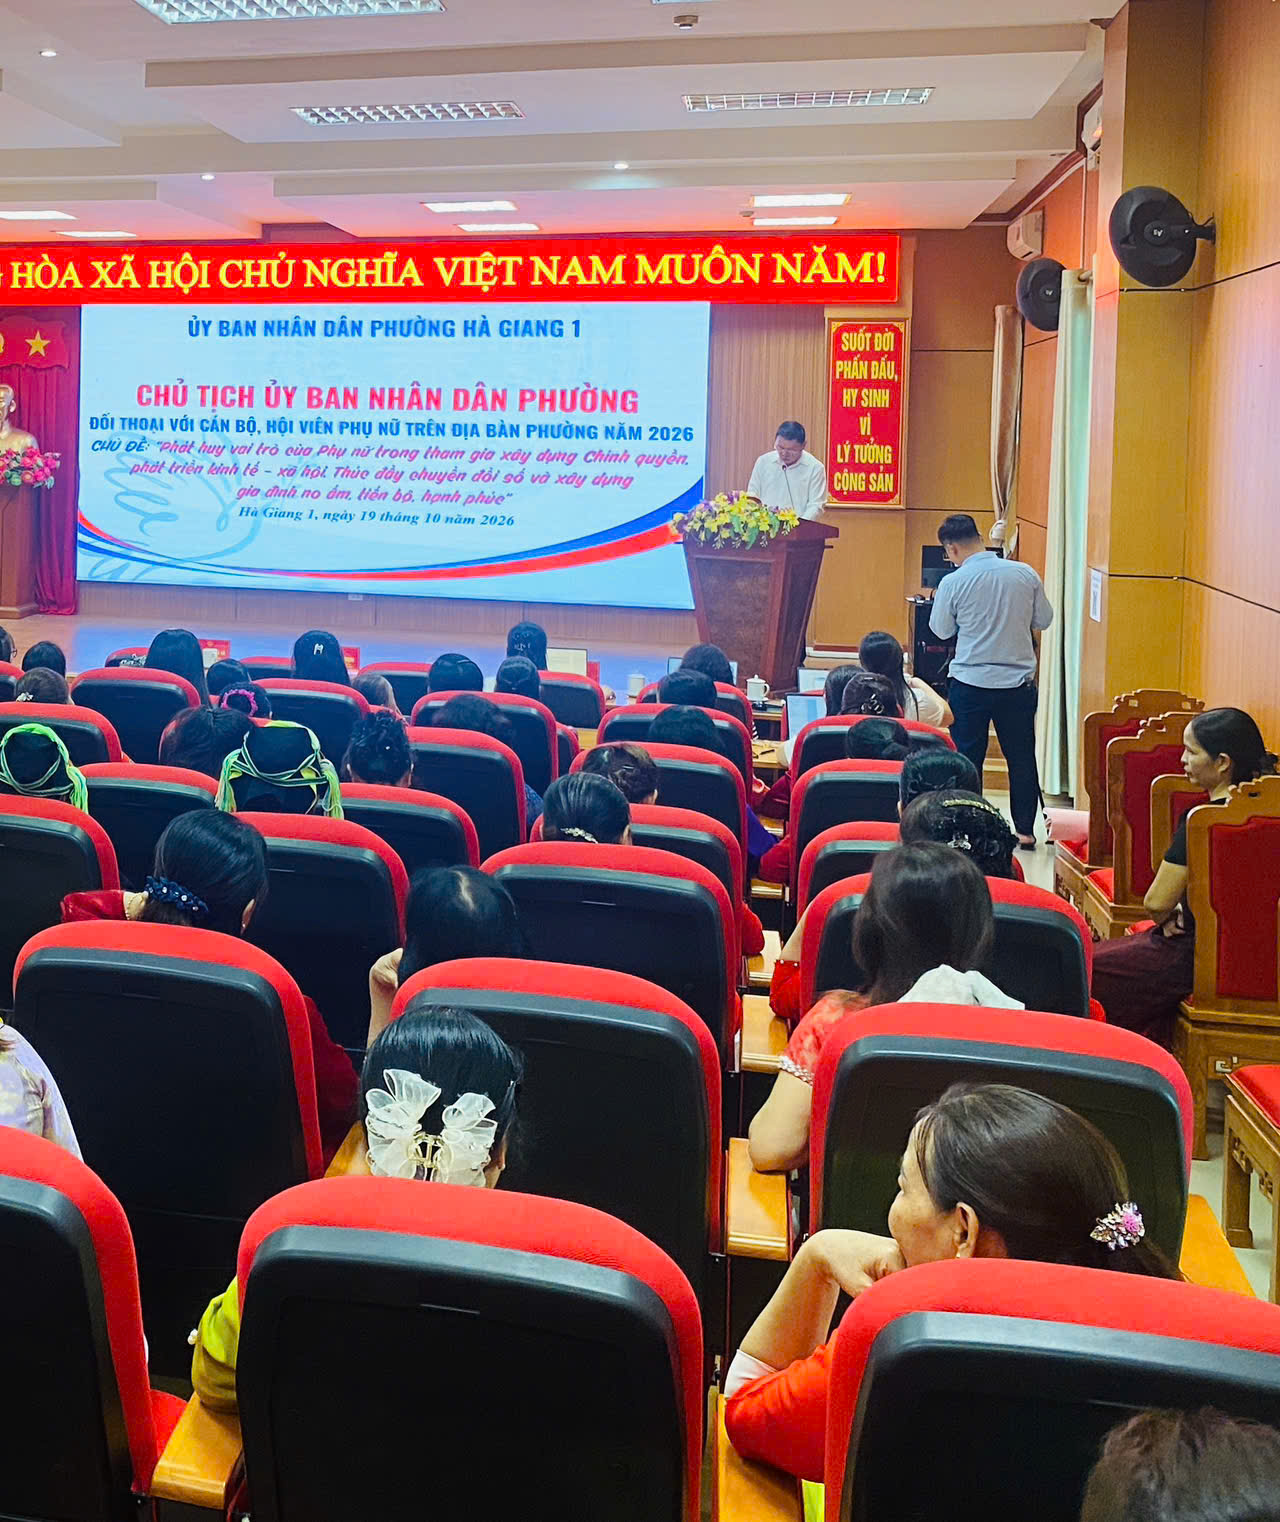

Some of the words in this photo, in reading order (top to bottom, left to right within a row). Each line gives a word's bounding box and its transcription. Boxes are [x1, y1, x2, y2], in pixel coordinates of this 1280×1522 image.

[11, 254, 83, 289] HÒA
[91, 255, 141, 289] XÃ
[148, 253, 210, 295] HỘI
[220, 253, 293, 288] CHỦ
[303, 252, 424, 288] NGHĨA
[434, 252, 522, 292] VIỆT
[531, 256, 626, 285] NAM
[635, 245, 760, 285] MUÔN
[772, 245, 886, 284] NĂM!
[188, 317, 213, 338] ỦY
[219, 320, 257, 338] BAN
[263, 316, 317, 338] NHÂN
[323, 316, 364, 339] DÂN
[370, 316, 456, 339] PHƯỜNG
[462, 315, 492, 339] HÀ
[498, 319, 564, 339] GIANG
[571, 319, 581, 338] 1
[842, 326, 872, 352] SUỐT
[874, 328, 894, 352] ĐỜI
[836, 354, 868, 380] PHẤN
[871, 354, 898, 381] ĐẤU,
[136, 378, 188, 407] CHỦ
[196, 385, 254, 413] TỊCH
[264, 379, 297, 409] ỦY
[306, 387, 358, 410] BAN
[369, 381, 442, 411] NHÂN
[453, 381, 507, 411] DÂN
[518, 382, 639, 414] PHƯỜNG
[843, 388, 858, 408] HY
[861, 388, 890, 408] SINH
[89, 412, 114, 431] ĐỐI
[120, 417, 164, 435] THOẠI
[170, 417, 194, 432] VỚI
[200, 415, 230, 433] CÁN
[236, 417, 261, 436] BỘ,
[267, 417, 293, 437] HỘI
[299, 417, 332, 435] VIÊN
[339, 422, 372, 439] PHỤ
[378, 418, 400, 436] NỮ
[405, 419, 446, 437] TRÊN
[451, 424, 480, 441] ĐỊA
[486, 419, 521, 439] BÀN
[527, 420, 598, 440] PHƯỜNG
[605, 422, 642, 441] NĂM
[648, 426, 694, 441] 2026
[859, 412, 871, 435] VÌ
[200, 442, 225, 457] huy
[230, 443, 253, 455] vai
[317, 445, 345, 459] Phụ
[374, 446, 419, 463] trong
[424, 446, 465, 460] tham
[469, 448, 495, 463] gia
[837, 441, 852, 464] LÝ
[854, 438, 892, 464] TƯỞNG
[129, 460, 165, 475] phát
[208, 464, 239, 476] kinh
[531, 472, 551, 484] và
[834, 468, 866, 495] CỘNG
[869, 465, 894, 492] SẢN
[236, 487, 261, 501] gia
[301, 490, 321, 500] no
[239, 507, 258, 517] Hà
[263, 507, 304, 521] Giang
[322, 511, 356, 523] ngày
[361, 510, 377, 521] 19
[380, 512, 419, 525] tháng
[425, 513, 441, 524] 10
[445, 514, 475, 525] năm
[480, 514, 514, 526] 2026
